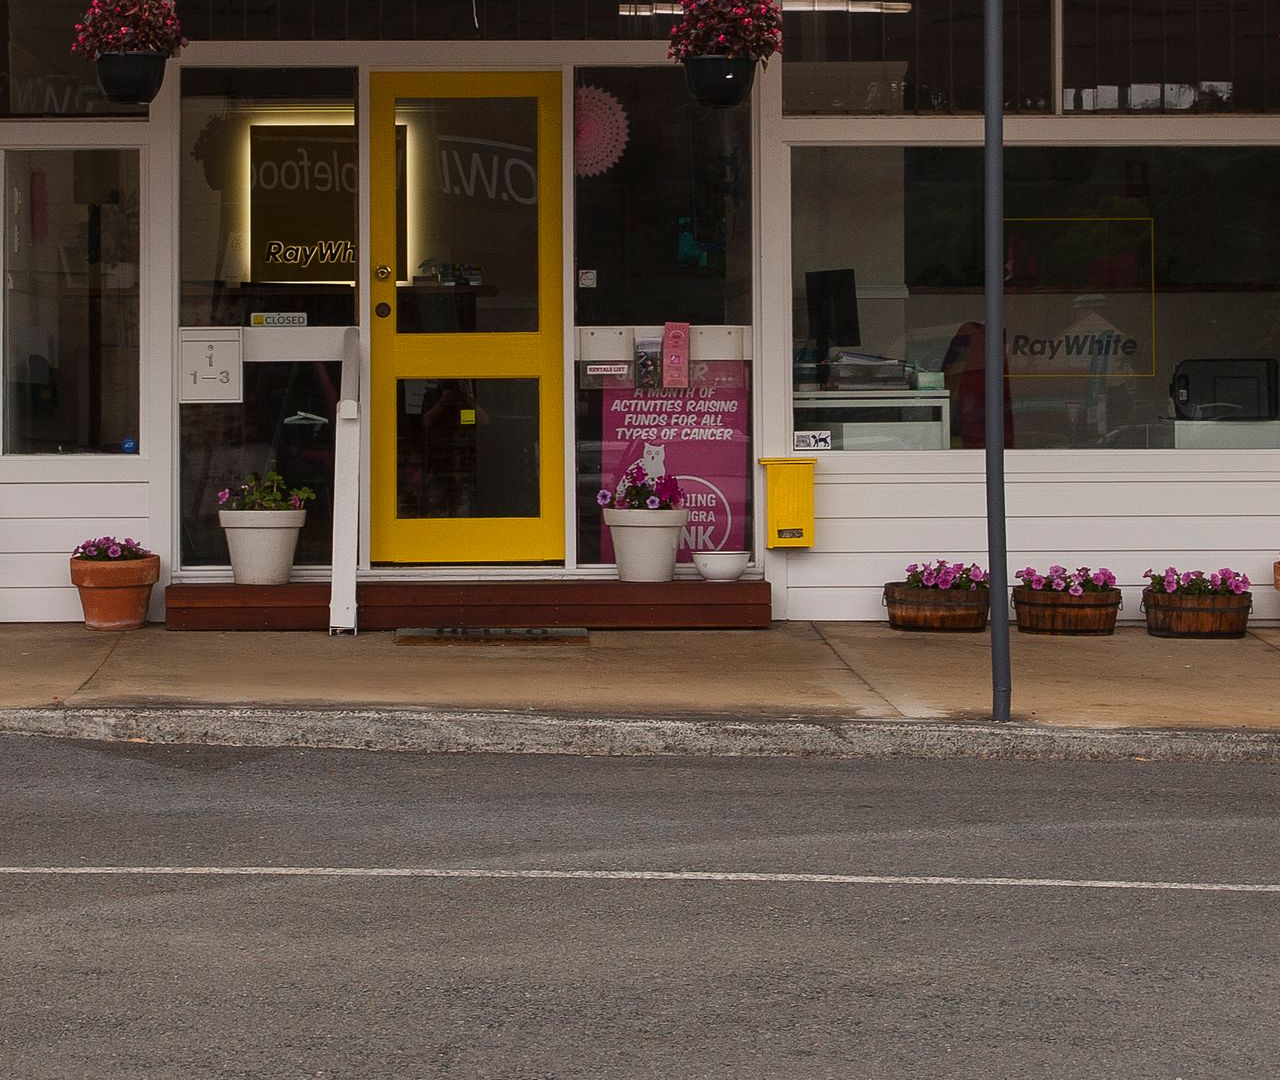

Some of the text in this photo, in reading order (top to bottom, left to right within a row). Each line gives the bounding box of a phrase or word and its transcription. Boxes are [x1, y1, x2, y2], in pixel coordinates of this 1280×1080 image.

[265, 241, 356, 268] RayWh
[265, 316, 305, 325] CLOSED
[1012, 334, 1137, 360] RayWhite
[634, 387, 716, 398] A MONTH OF
[611, 400, 738, 412] ACTIVITIES RAISING
[624, 414, 724, 426] FUNDS FOR ALL
[616, 428, 733, 440] TYPES OF CANCER
